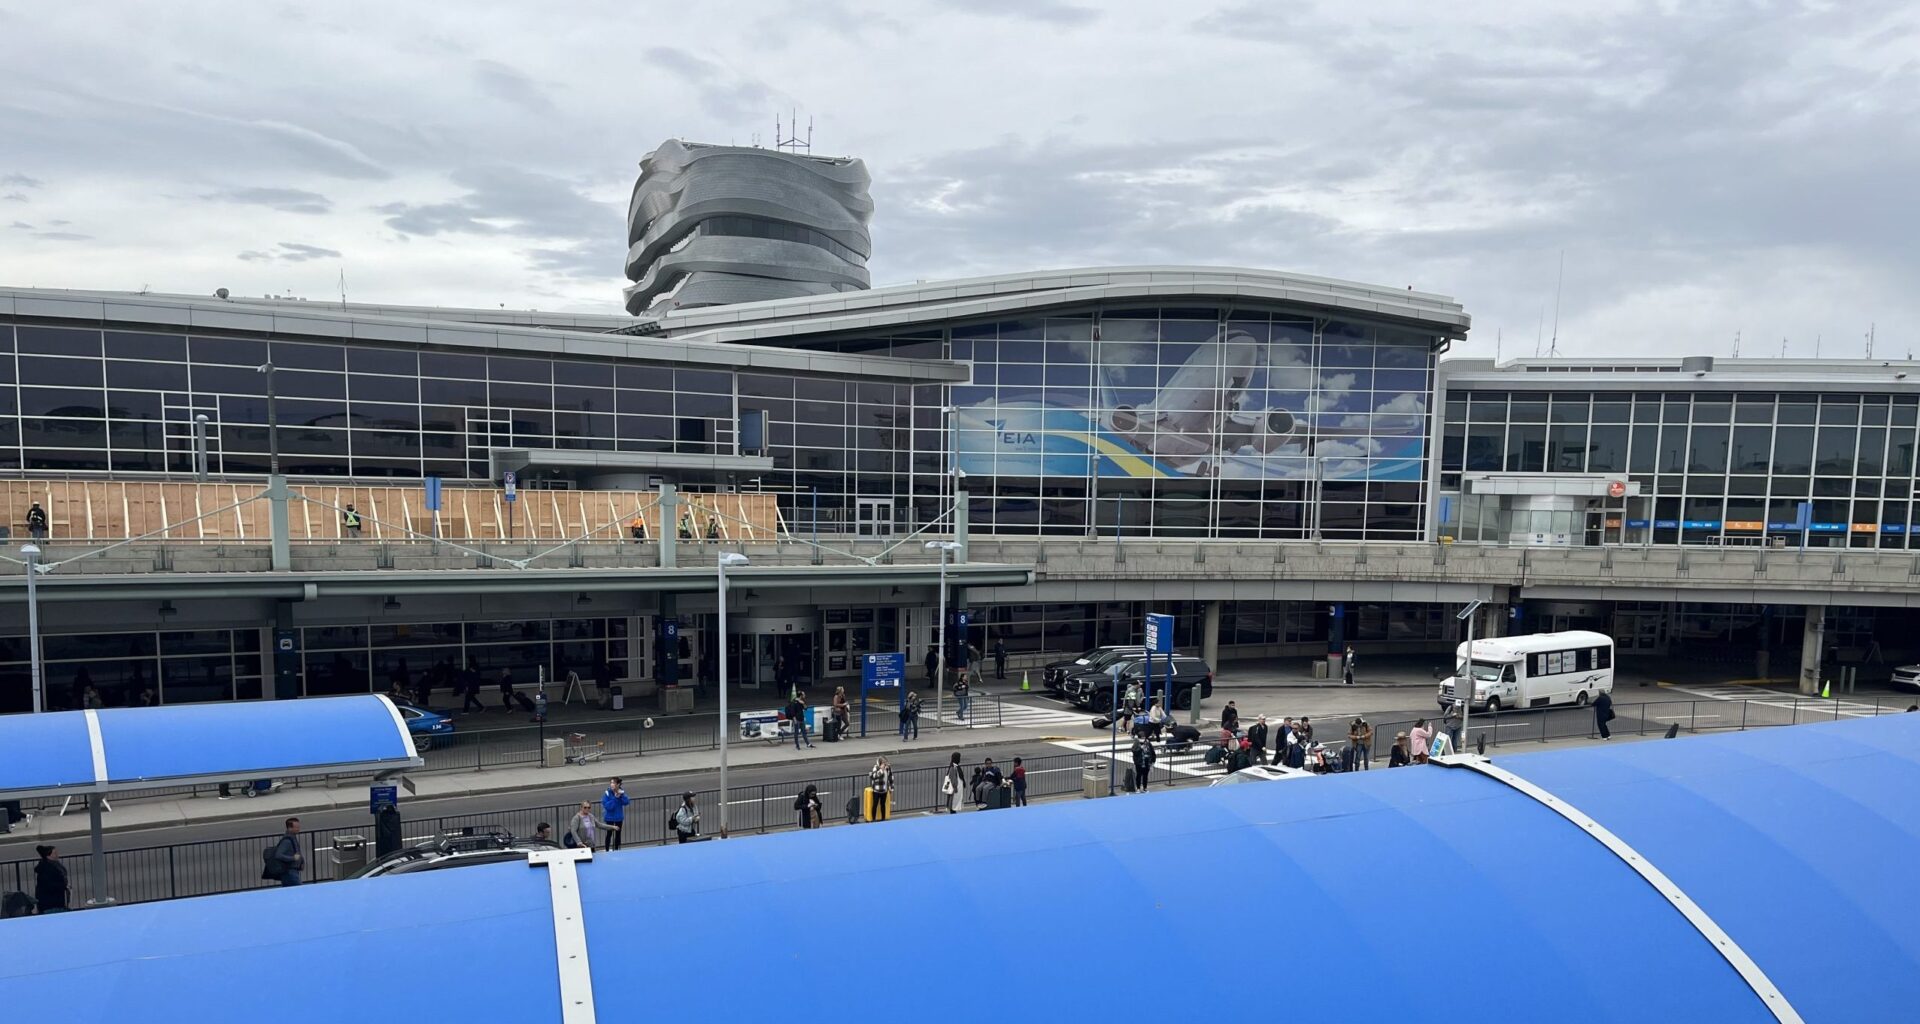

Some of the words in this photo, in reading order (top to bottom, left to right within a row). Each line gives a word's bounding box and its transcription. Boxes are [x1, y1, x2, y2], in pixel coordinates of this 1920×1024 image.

[1004, 432, 1036, 445] EIA
[960, 615, 966, 624] 8
[668, 625, 675, 635] 8
